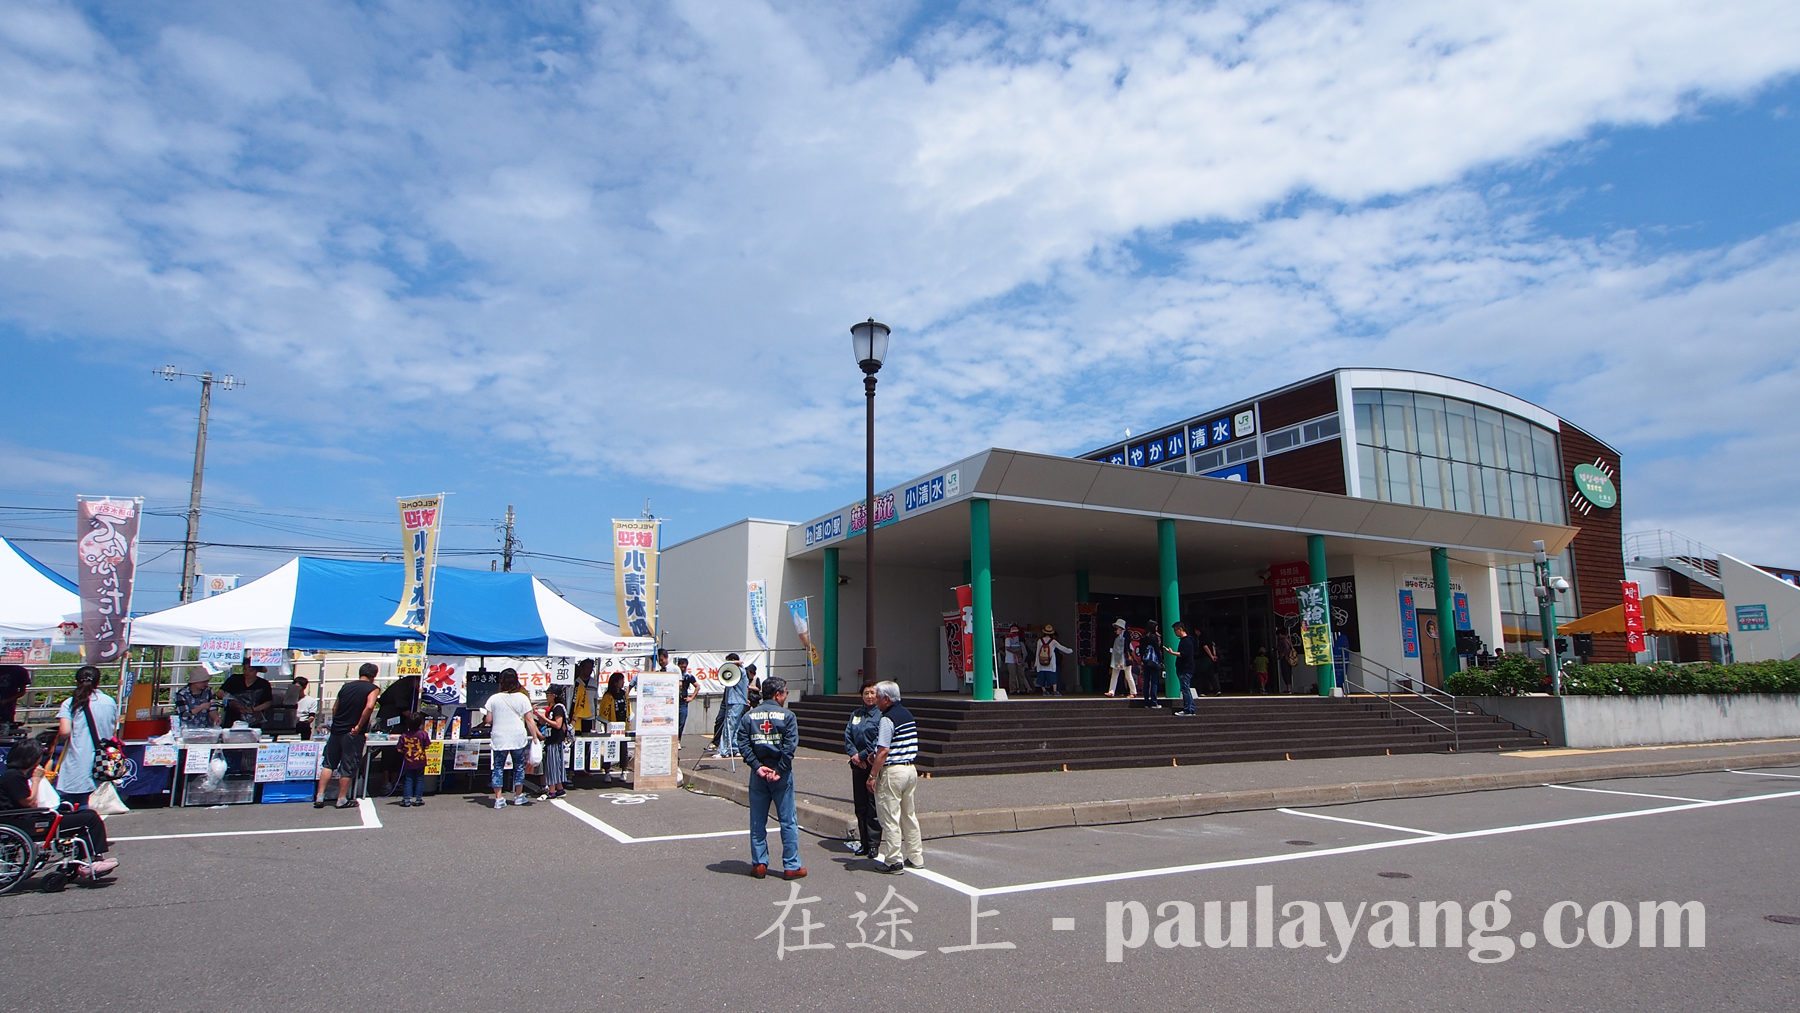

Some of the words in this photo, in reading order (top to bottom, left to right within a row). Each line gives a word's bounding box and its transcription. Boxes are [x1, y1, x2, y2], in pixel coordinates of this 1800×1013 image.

[1238, 415, 1249, 425] JR
[1100, 421, 1229, 466] なやか小清水
[948, 473, 957, 484] JR
[816, 517, 840, 540] 道の駅
[906, 479, 943, 508] 小清水
[1328, 581, 1353, 595] の駅
[1405, 580, 1435, 589] はなの花フェス
[202, 640, 243, 651] 小清水町止別
[557, 656, 570, 681] 本部
[426, 663, 456, 689] 氷
[471, 674, 498, 683] かき氷
